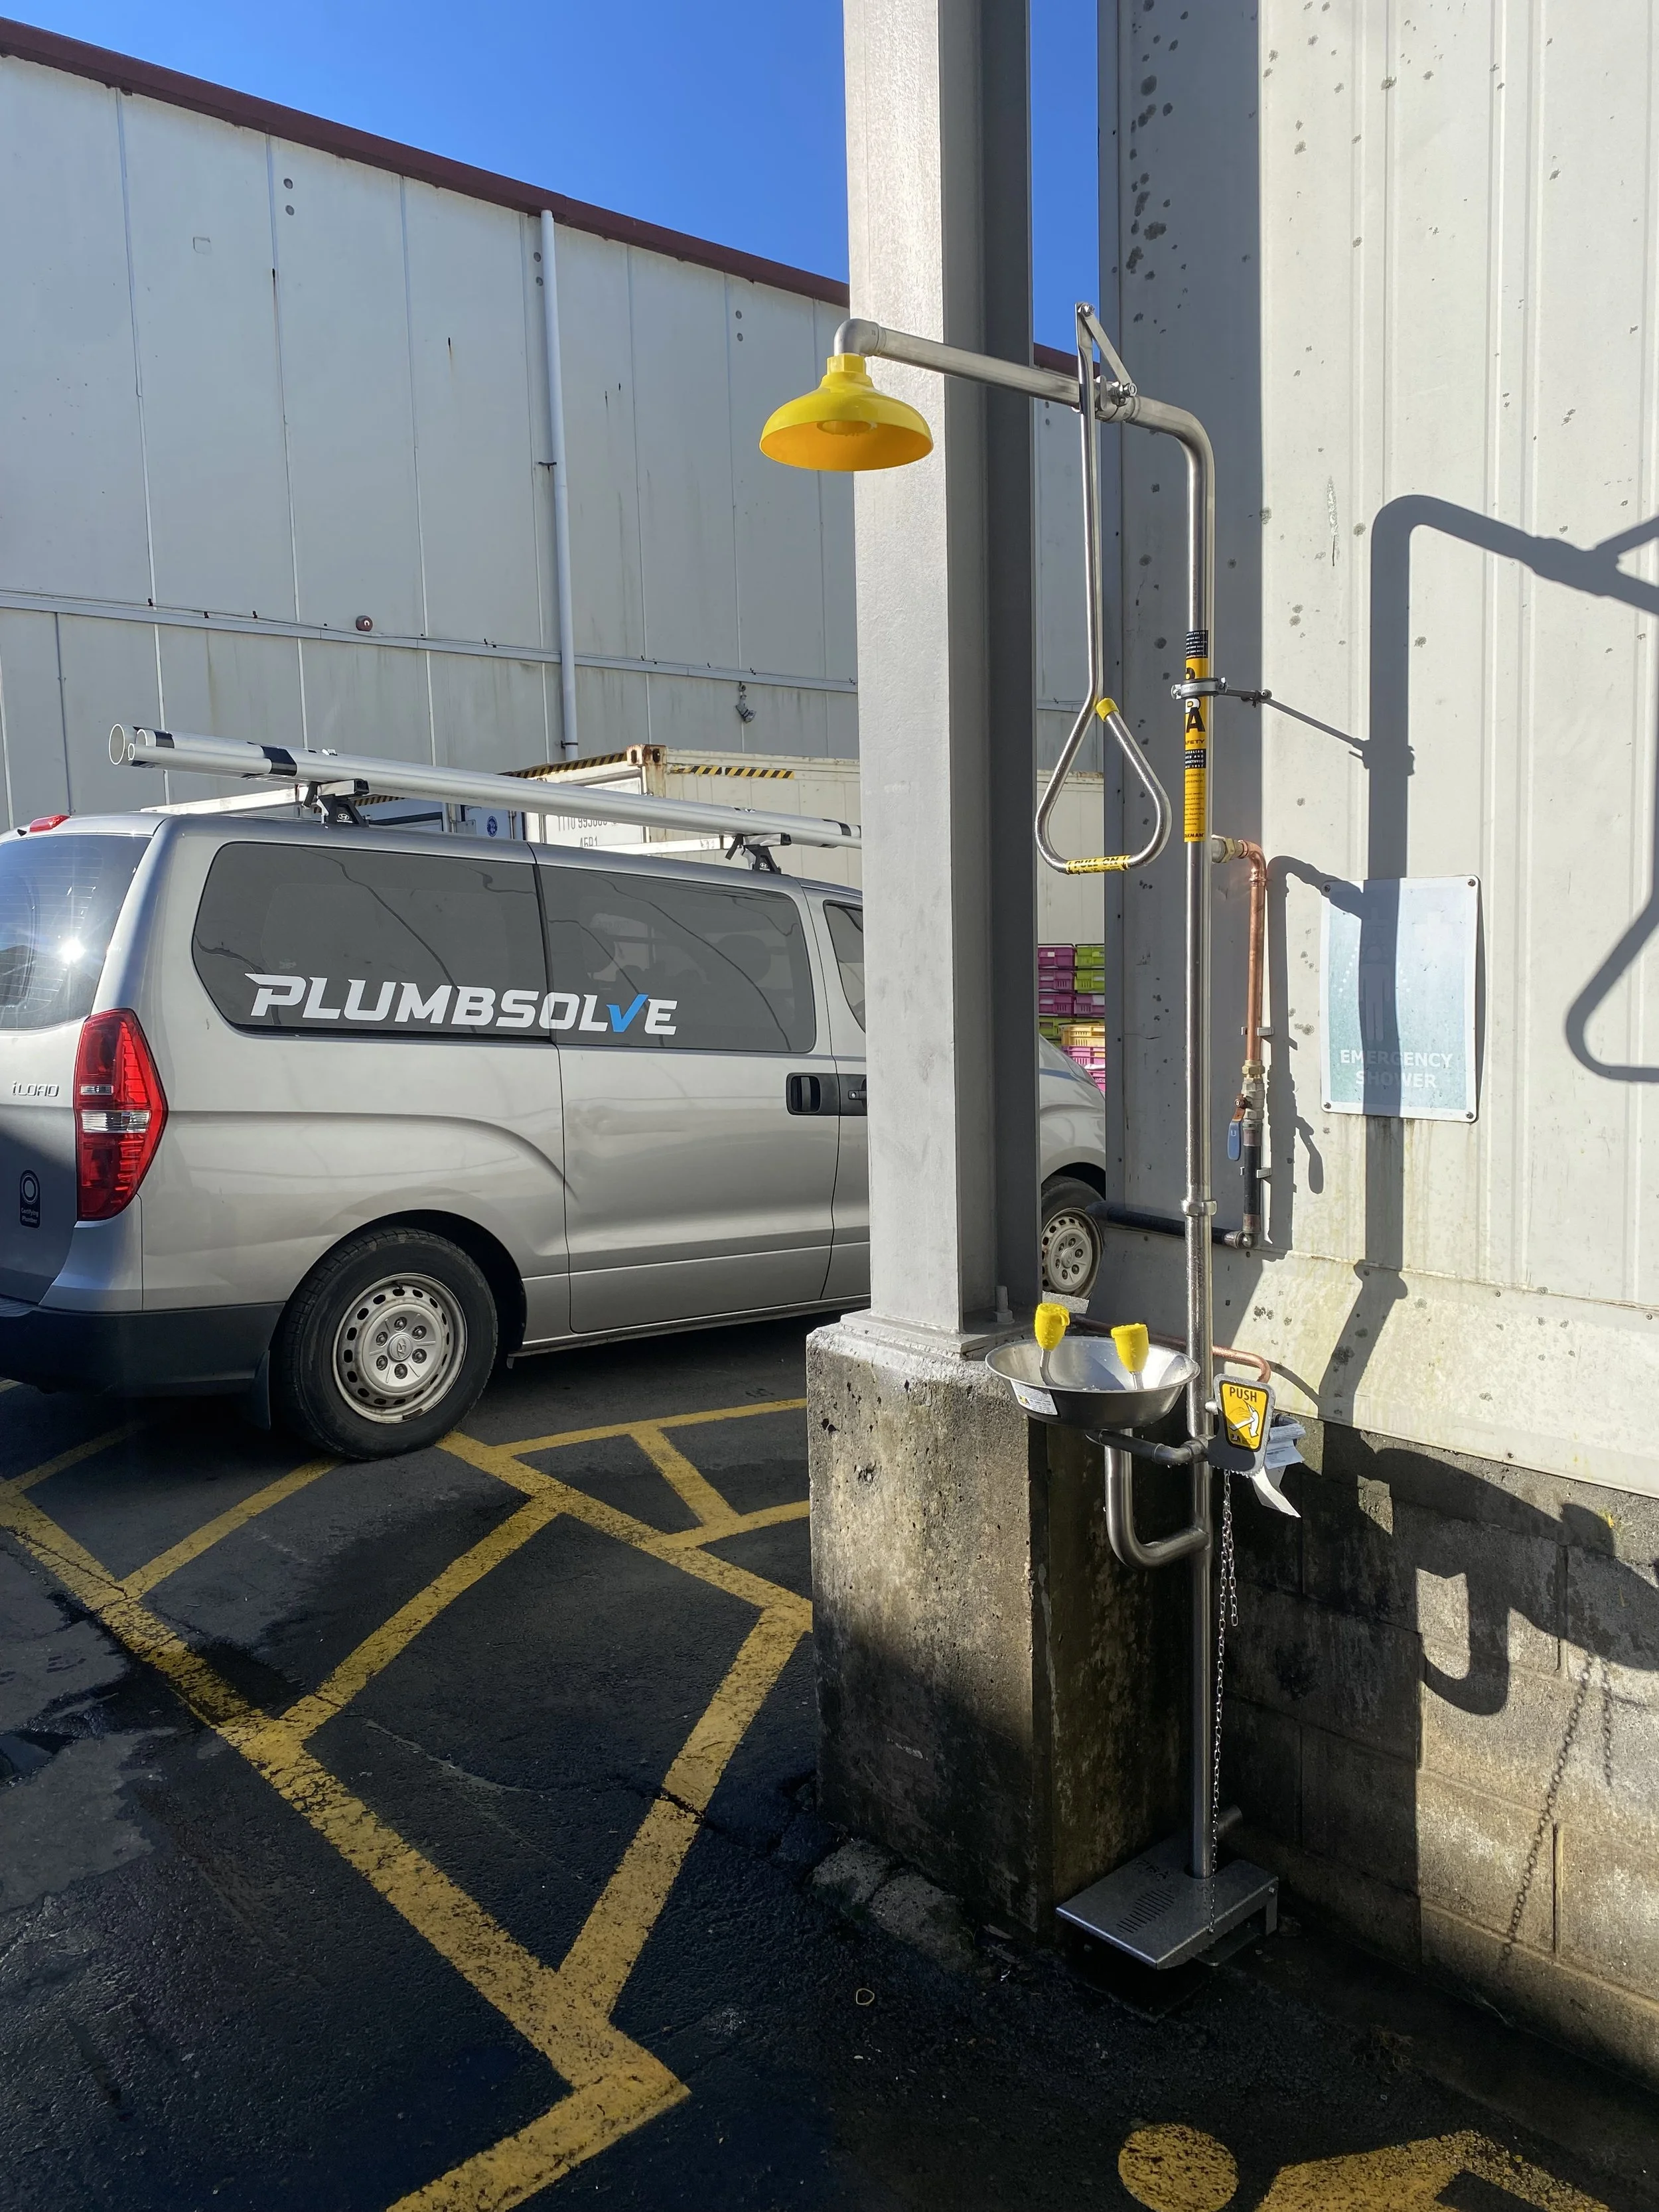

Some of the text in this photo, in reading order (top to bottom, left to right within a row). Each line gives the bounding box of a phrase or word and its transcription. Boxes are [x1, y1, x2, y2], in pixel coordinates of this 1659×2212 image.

[1074, 857, 1119, 869] PULL ON
[244, 972, 678, 1035] PLUMBSOLVE
[1340, 1049, 1453, 1069] EMERGENCY
[1356, 1070, 1437, 1088] SHOWER
[1229, 1386, 1257, 1402] PUSH
